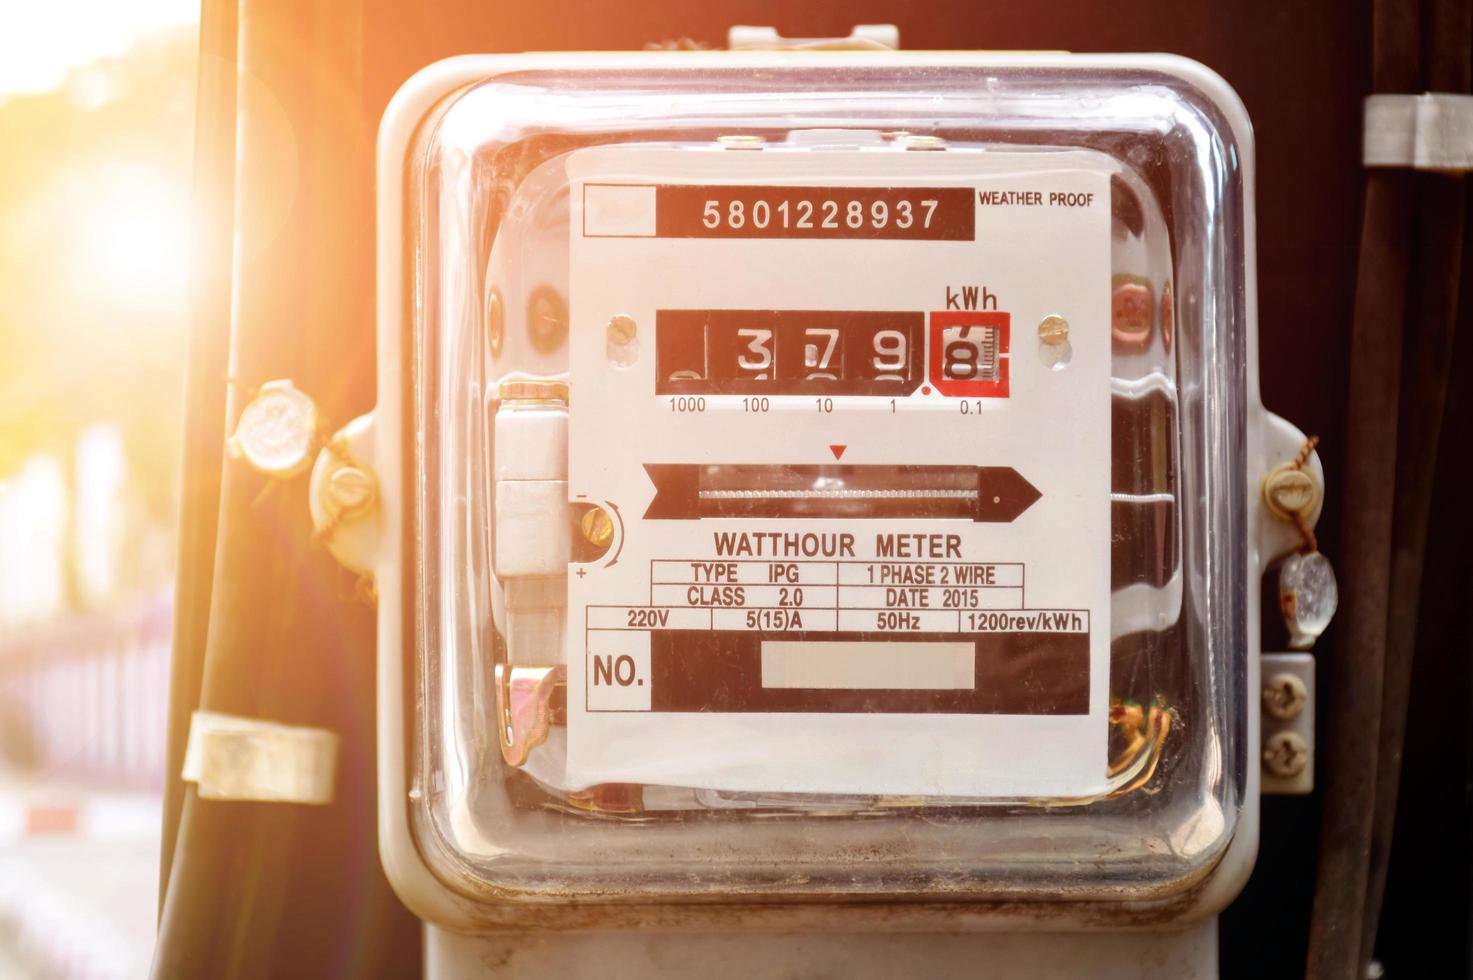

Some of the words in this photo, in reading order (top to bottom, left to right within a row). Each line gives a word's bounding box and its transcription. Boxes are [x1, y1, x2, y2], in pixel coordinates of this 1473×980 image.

[979, 191, 1043, 206] WEATHER
[1049, 192, 1094, 207] PROOF
[702, 199, 938, 229] 5801228937
[946, 285, 998, 311] kWh
[670, 397, 706, 413] 1000
[743, 397, 770, 413] 100
[816, 398, 833, 414] 10
[960, 400, 983, 416] 0.1
[714, 533, 856, 558] WATTHOUR
[876, 534, 962, 559] METER
[691, 564, 738, 583] TYPE
[768, 565, 800, 583] IPG
[867, 566, 874, 584] 1
[880, 566, 935, 585] PHASE
[940, 566, 949, 584] 2
[953, 566, 996, 585] WIRE
[687, 588, 746, 607] CLASS
[778, 588, 804, 607] 2.0
[886, 589, 930, 608] DATE
[942, 589, 979, 609] 2015
[627, 610, 670, 628] 220V
[746, 611, 803, 631] 5(15)A
[876, 613, 921, 631] 50Hz
[968, 613, 1082, 632] 1200rev/kWh
[593, 653, 644, 687] NO.
